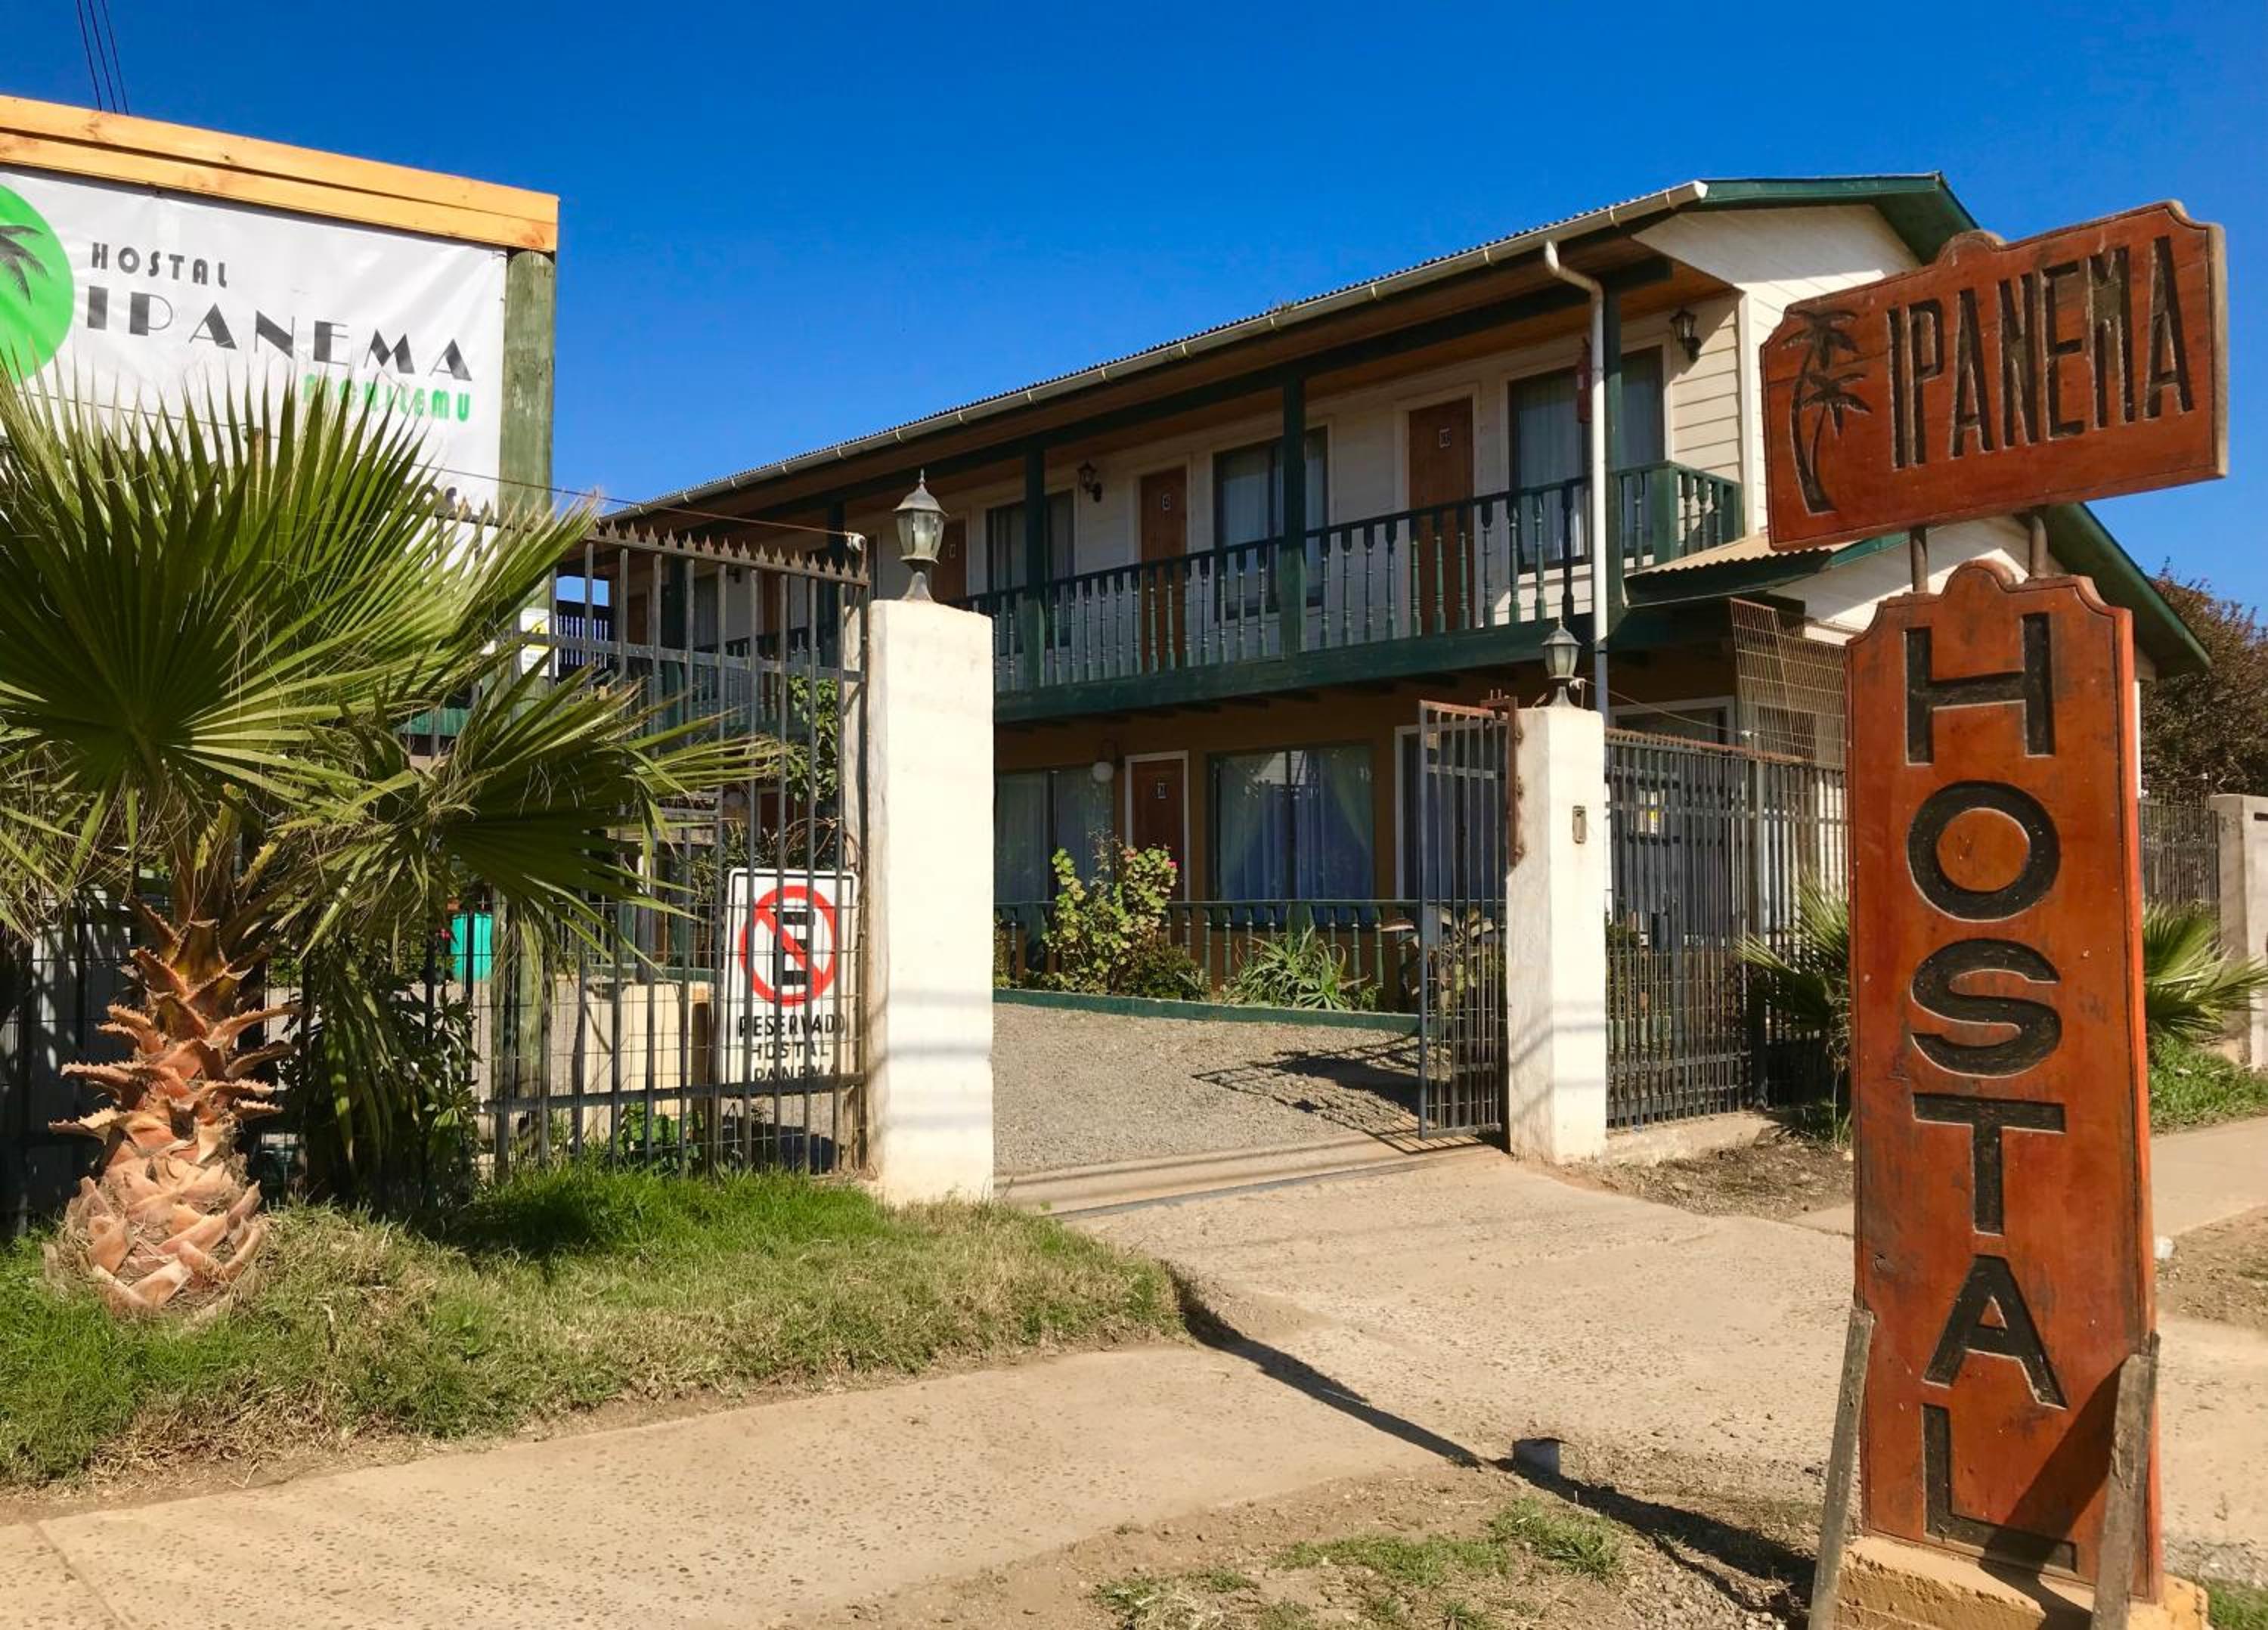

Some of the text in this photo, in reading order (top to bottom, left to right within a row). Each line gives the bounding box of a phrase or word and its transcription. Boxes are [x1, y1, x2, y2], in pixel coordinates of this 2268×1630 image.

[91, 242, 227, 288] HOSTAL
[87, 285, 472, 381] IPANEMA
[1888, 236, 2193, 470] IPANEMA
[753, 1064, 837, 1081] PANEMA
[1904, 611, 2077, 1574] HOSTAL
